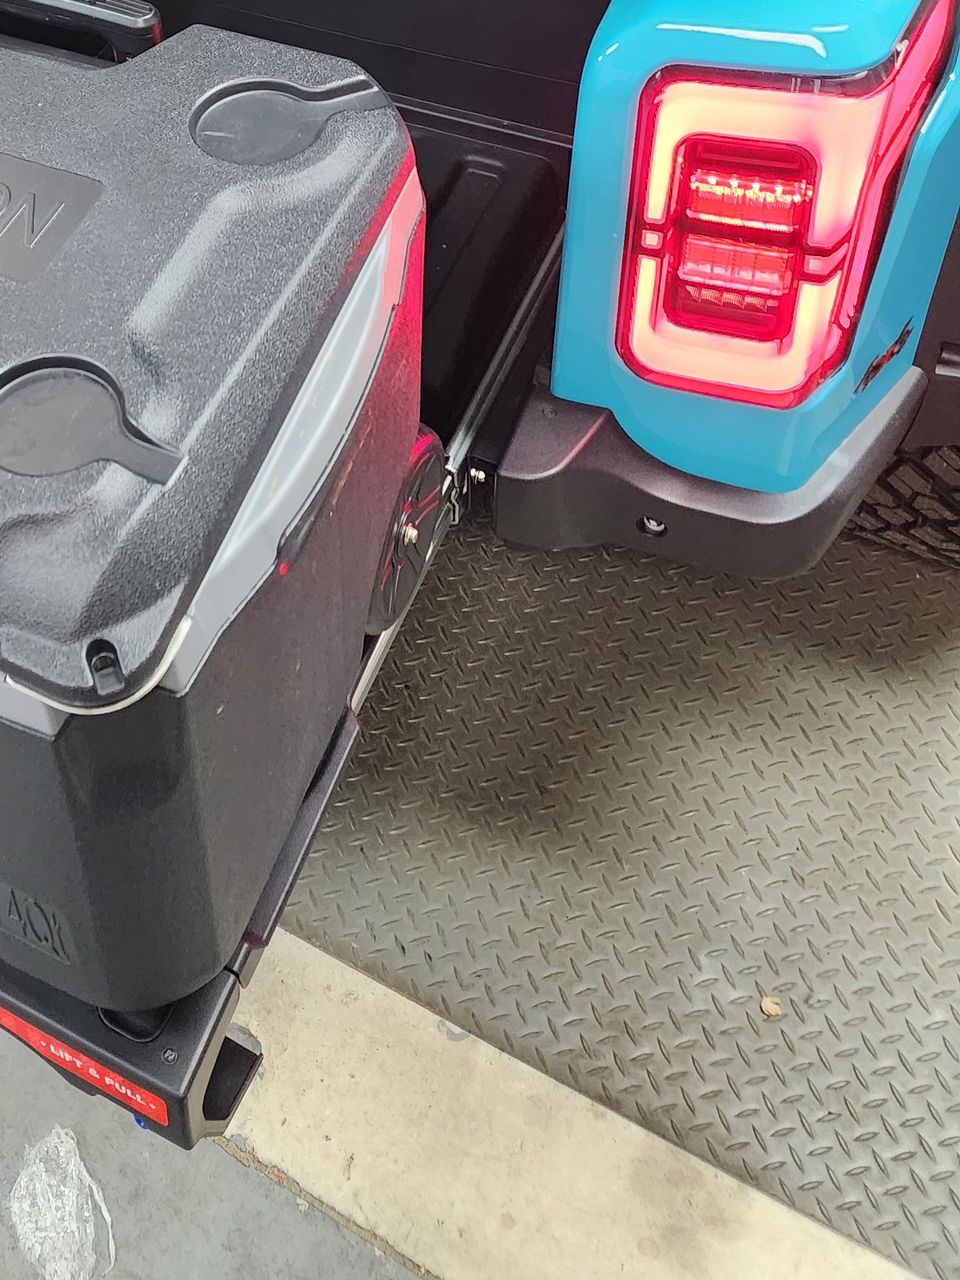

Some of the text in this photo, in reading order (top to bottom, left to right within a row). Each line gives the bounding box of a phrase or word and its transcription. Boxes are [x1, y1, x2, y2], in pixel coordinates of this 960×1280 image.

[49, 1043, 146, 1106] LIFT & PULL
